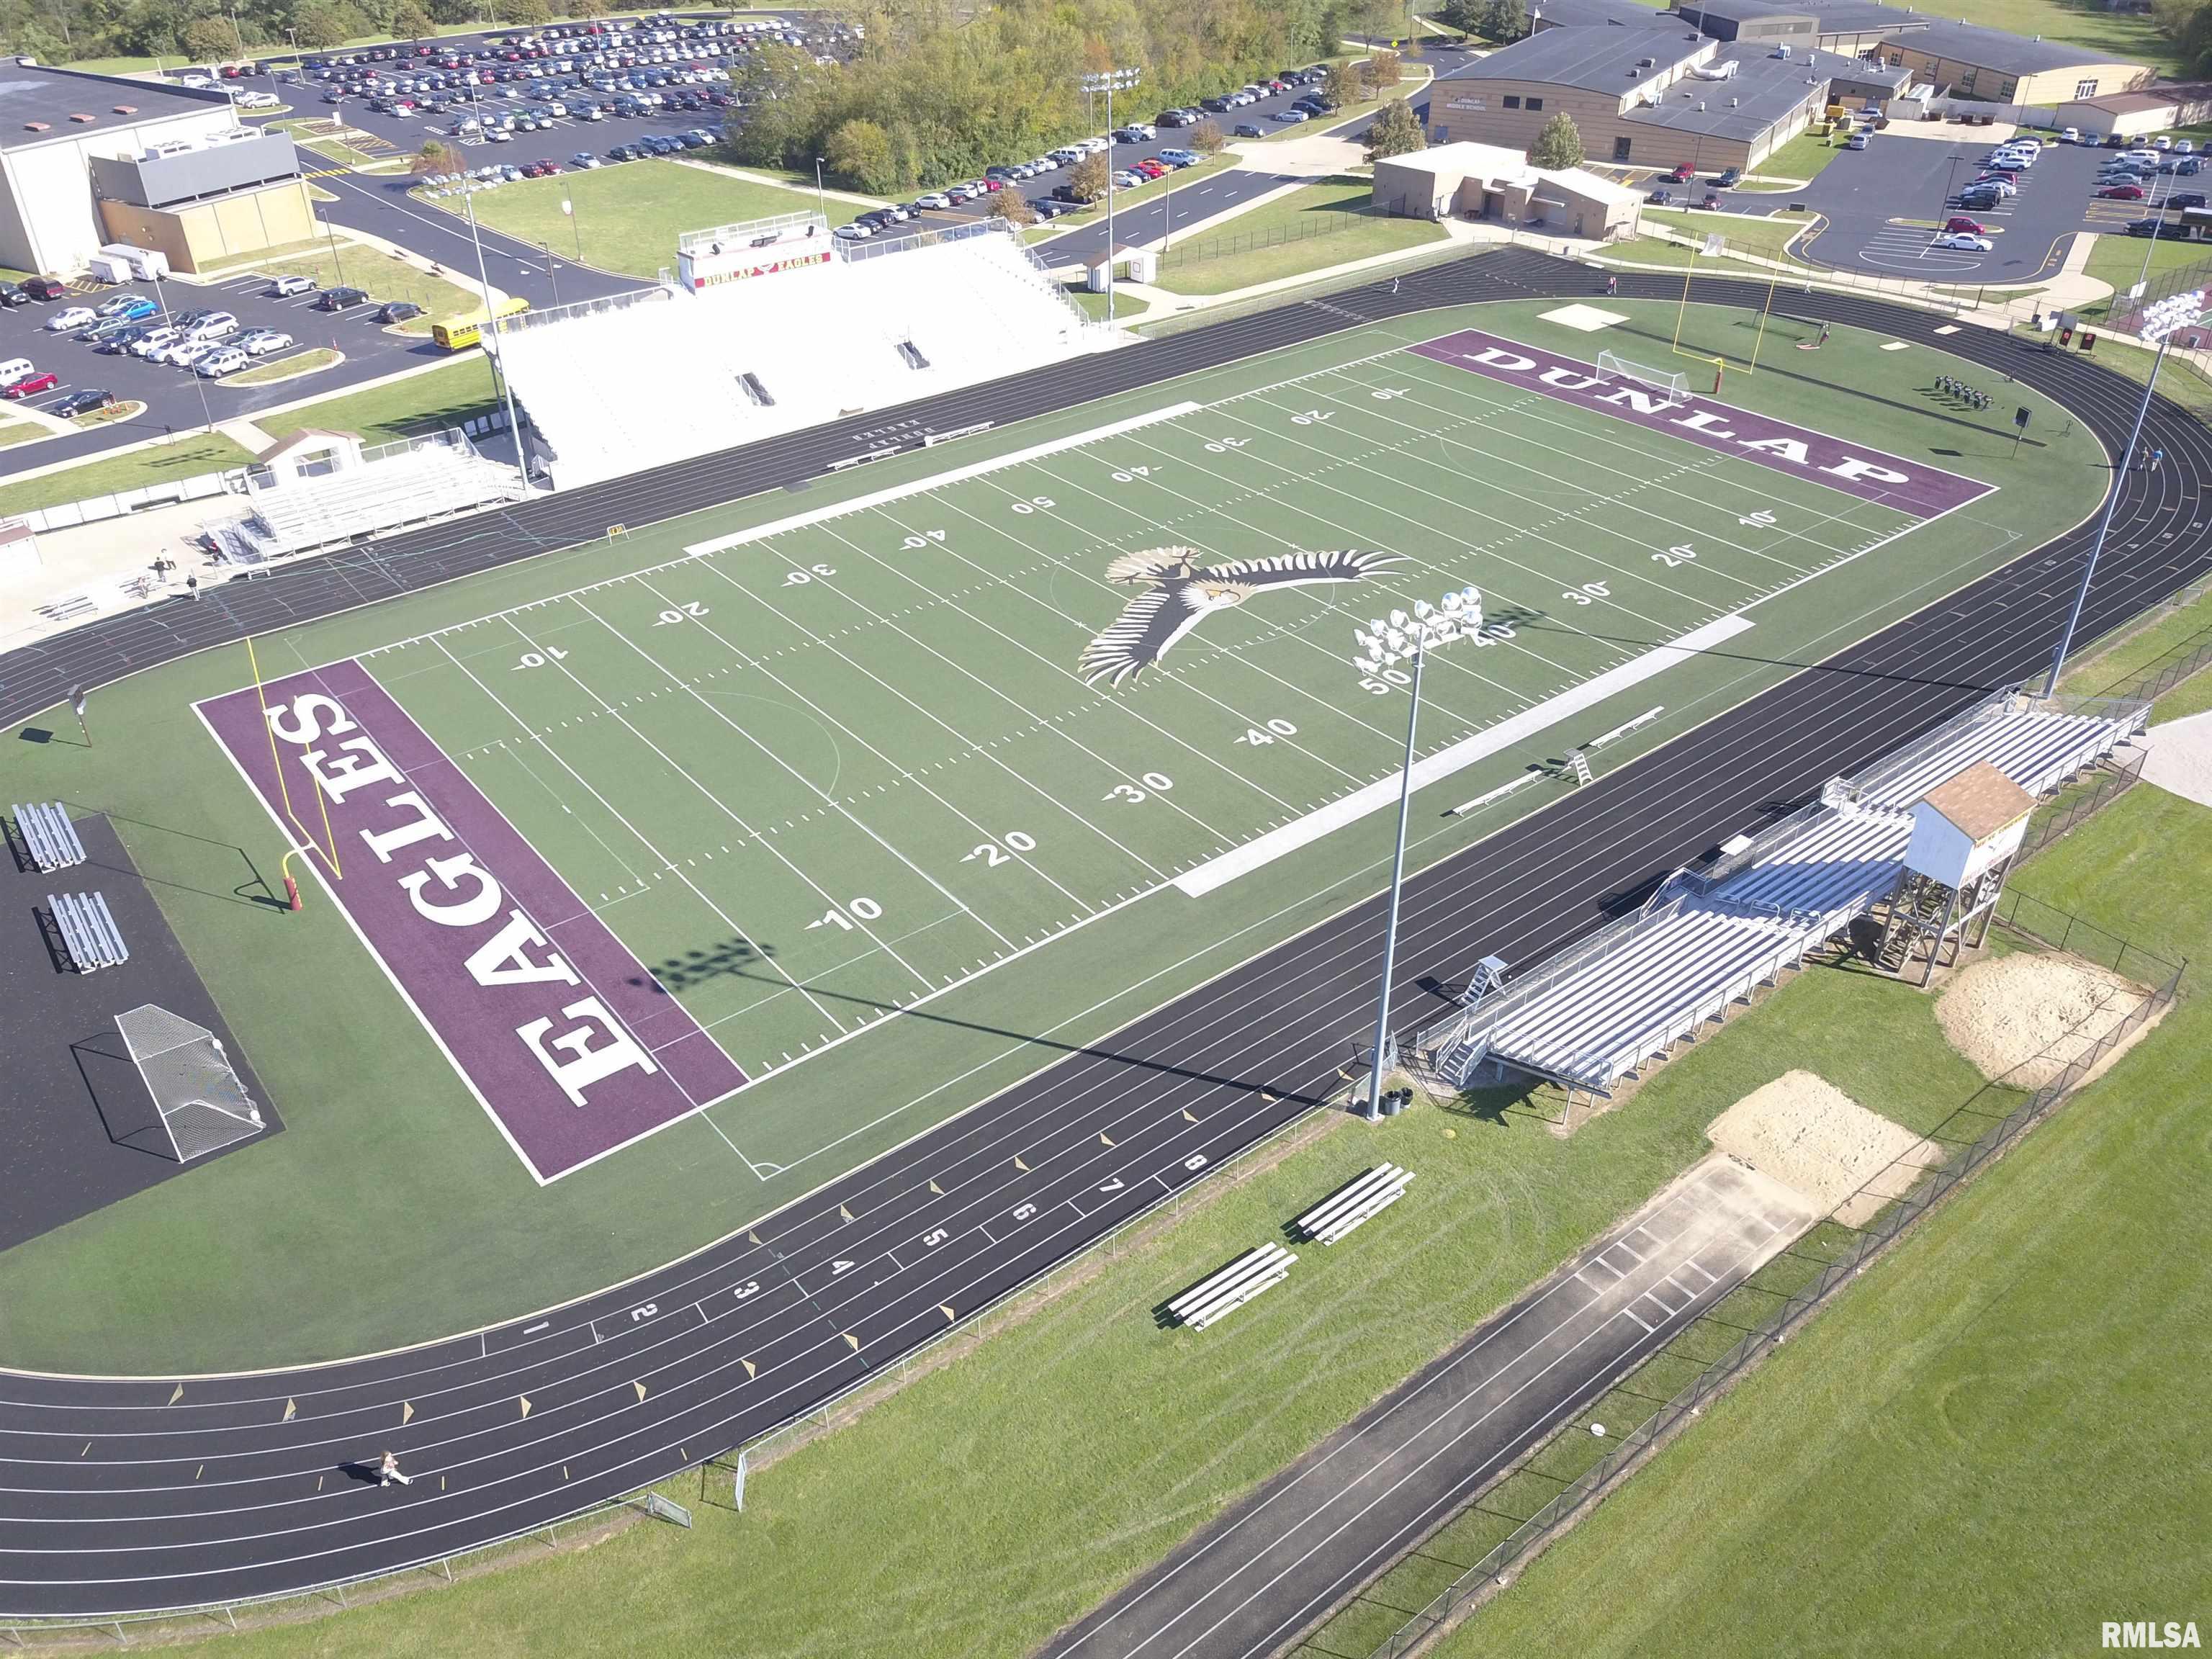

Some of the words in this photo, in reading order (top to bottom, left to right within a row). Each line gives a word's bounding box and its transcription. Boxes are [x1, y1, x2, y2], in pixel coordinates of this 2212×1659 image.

[703, 266, 755, 287] DUNLAP
[778, 254, 824, 271] EAGLES
[1371, 388, 1403, 400] 10
[1291, 410, 1330, 425] 20
[1462, 346, 1910, 484] DUNLAP
[1204, 437, 1245, 452] 30
[1111, 466, 1149, 482] 40
[1011, 496, 1056, 514] 50
[1738, 512, 1777, 528] 10
[904, 529, 945, 548] 40
[1651, 547, 1696, 567] 20
[787, 564, 837, 584] 30
[1562, 583, 1611, 606] 30
[659, 601, 709, 624] 20
[1472, 624, 1516, 647] 40
[520, 646, 569, 667] 10
[1357, 669, 1412, 695] 50
[1247, 719, 1298, 746] 40
[1113, 772, 1174, 804] 30
[973, 831, 1036, 868] 20
[262, 693, 659, 1108] EAGLES
[822, 897, 882, 931] 10
[1184, 1154, 1208, 1171] 8
[1099, 1177, 1125, 1192] 7
[1012, 1203, 1037, 1220] 6
[922, 1228, 949, 1246] 5
[832, 1260, 855, 1275] 4
[733, 1281, 760, 1300] 3
[631, 1303, 658, 1322] 2
[523, 1321, 549, 1335] 1
